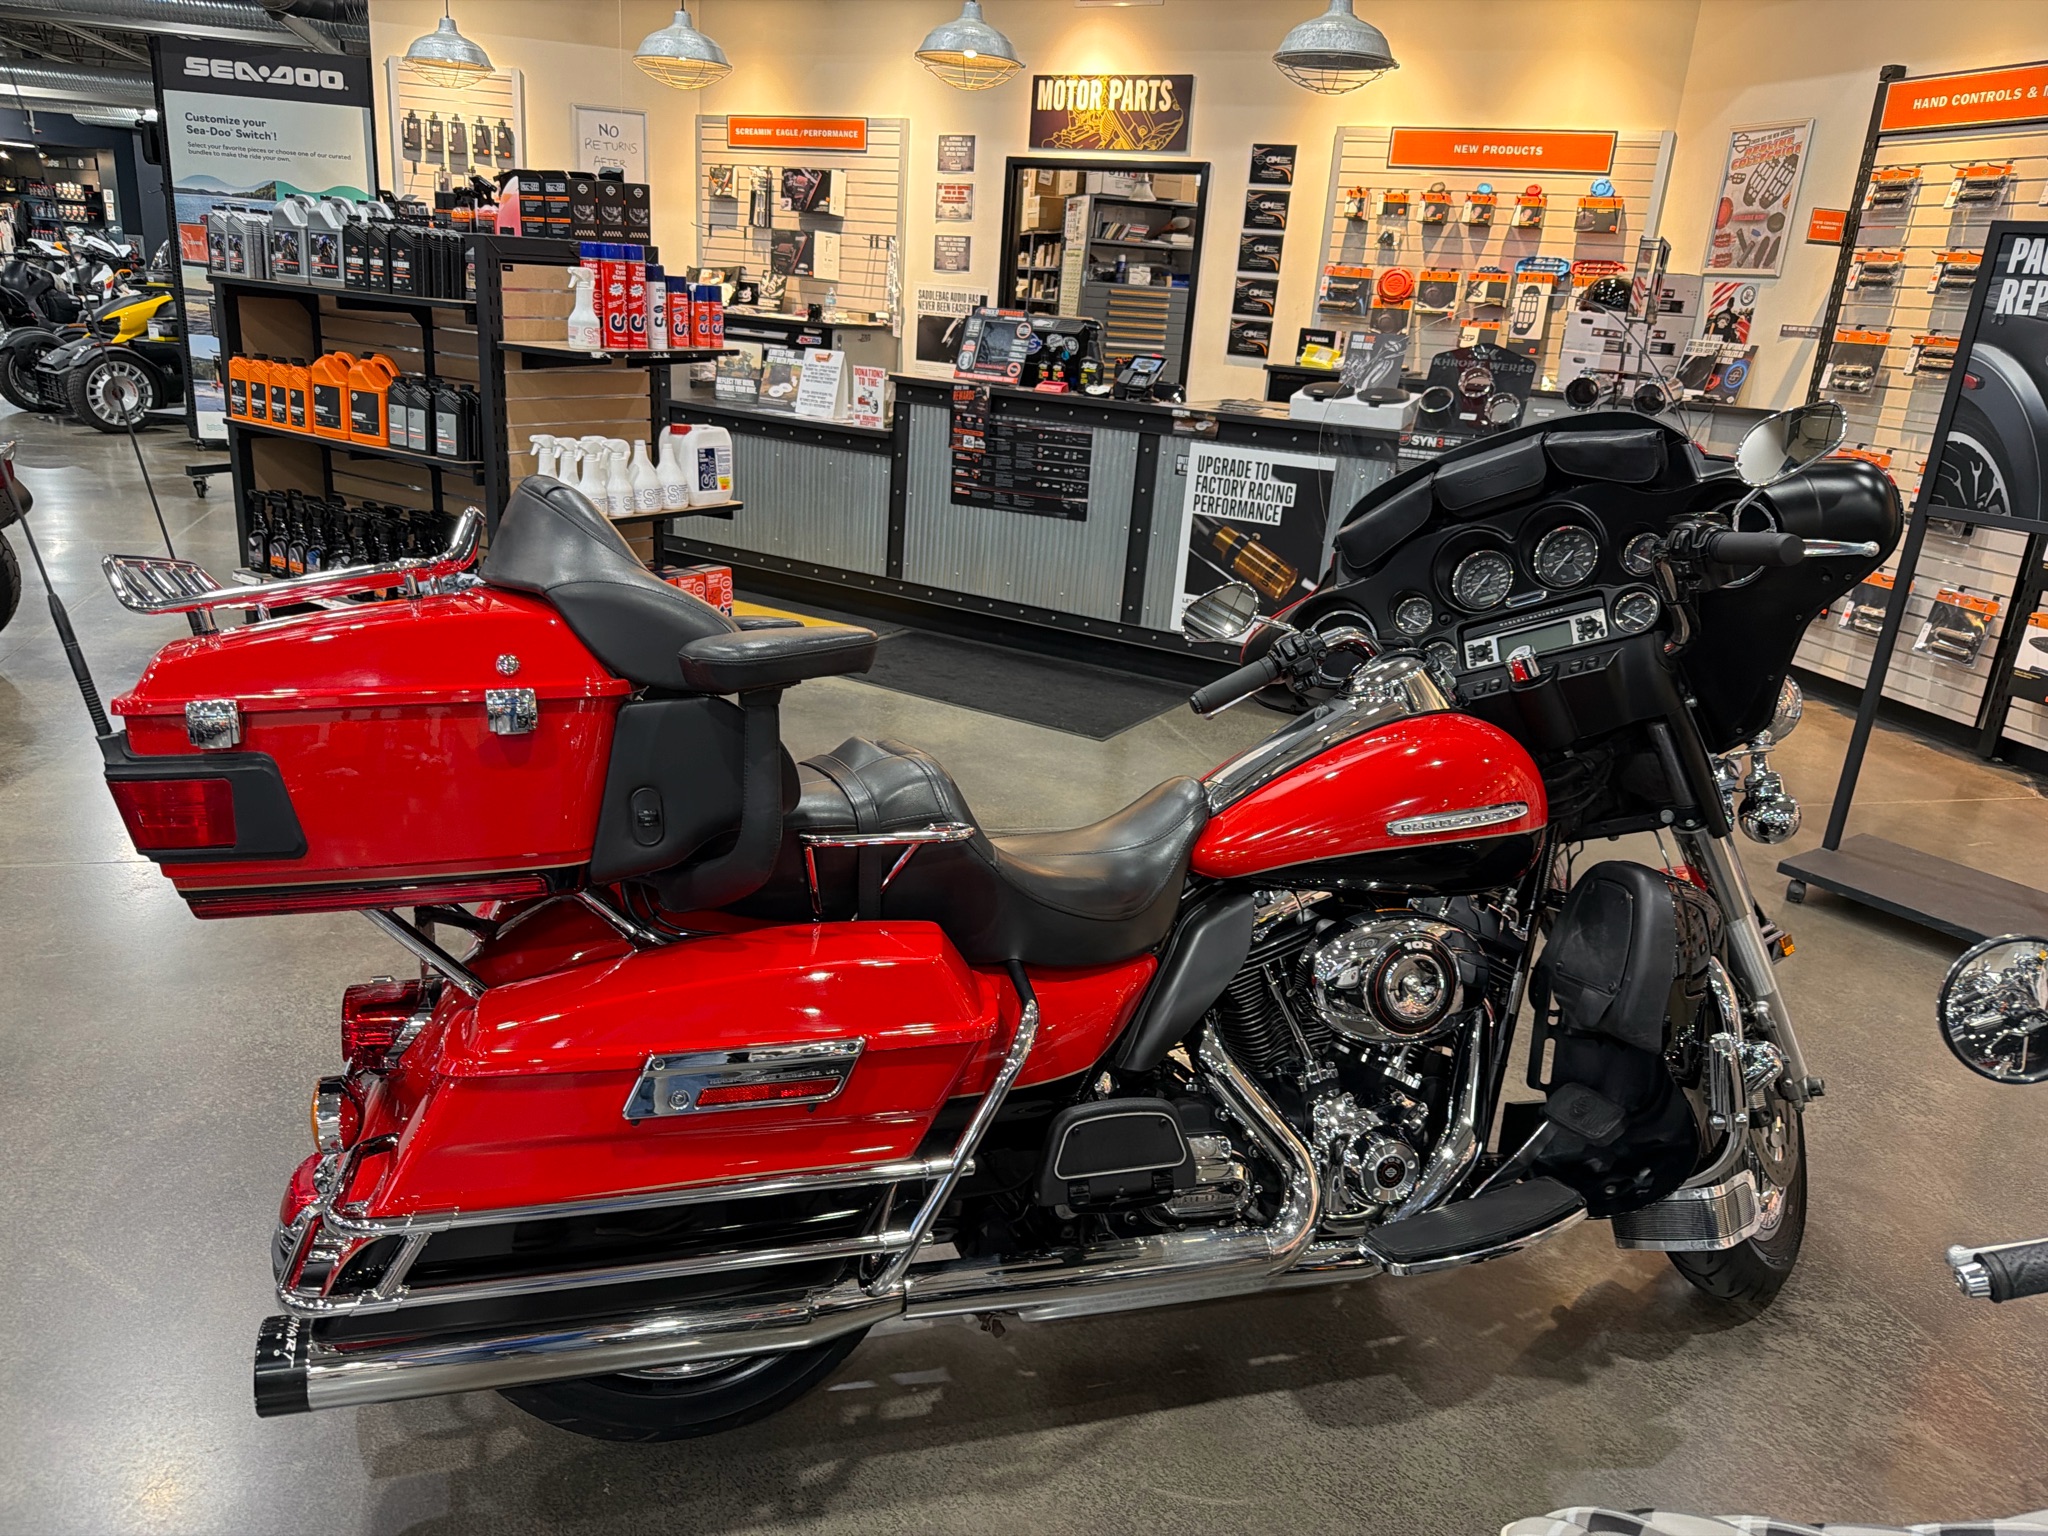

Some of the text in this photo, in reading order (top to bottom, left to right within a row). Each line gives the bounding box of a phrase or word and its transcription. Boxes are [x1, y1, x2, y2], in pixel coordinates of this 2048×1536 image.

[1037, 79, 1174, 112] MOTOR PARTS
[1912, 95, 1948, 110] HAND
[1951, 87, 2023, 106] CONTROLS
[2026, 85, 2038, 99] &
[184, 111, 267, 129] Customize your
[598, 123, 620, 138] NO
[187, 141, 207, 149] Select
[207, 143, 222, 151] your
[222, 143, 247, 152] favorite
[247, 146, 267, 154] pieces
[275, 148, 297, 156] choose
[188, 148, 212, 156] bundles
[584, 137, 638, 155] RETURNS
[1453, 144, 1544, 156] NEW PRODUCTS
[593, 155, 628, 168] AFTER
[2006, 237, 2048, 275] PA
[918, 289, 979, 304] SADDLEBAG AUDIO HAS
[917, 299, 972, 314] NEVER BEEN EASIER
[1433, 357, 1535, 374] KHROME WERKS
[854, 368, 884, 379] DONATIONS
[858, 377, 866, 386] TO
[1411, 435, 1445, 448] SYN3
[1197, 454, 1253, 479] UPGRADE
[1255, 461, 1270, 482] TO
[1194, 474, 1294, 505] FACTORY RACING
[1192, 494, 1281, 523] PERFORMANCE
[1404, 941, 1433, 950] 103
[282, 1316, 300, 1369] EHART
